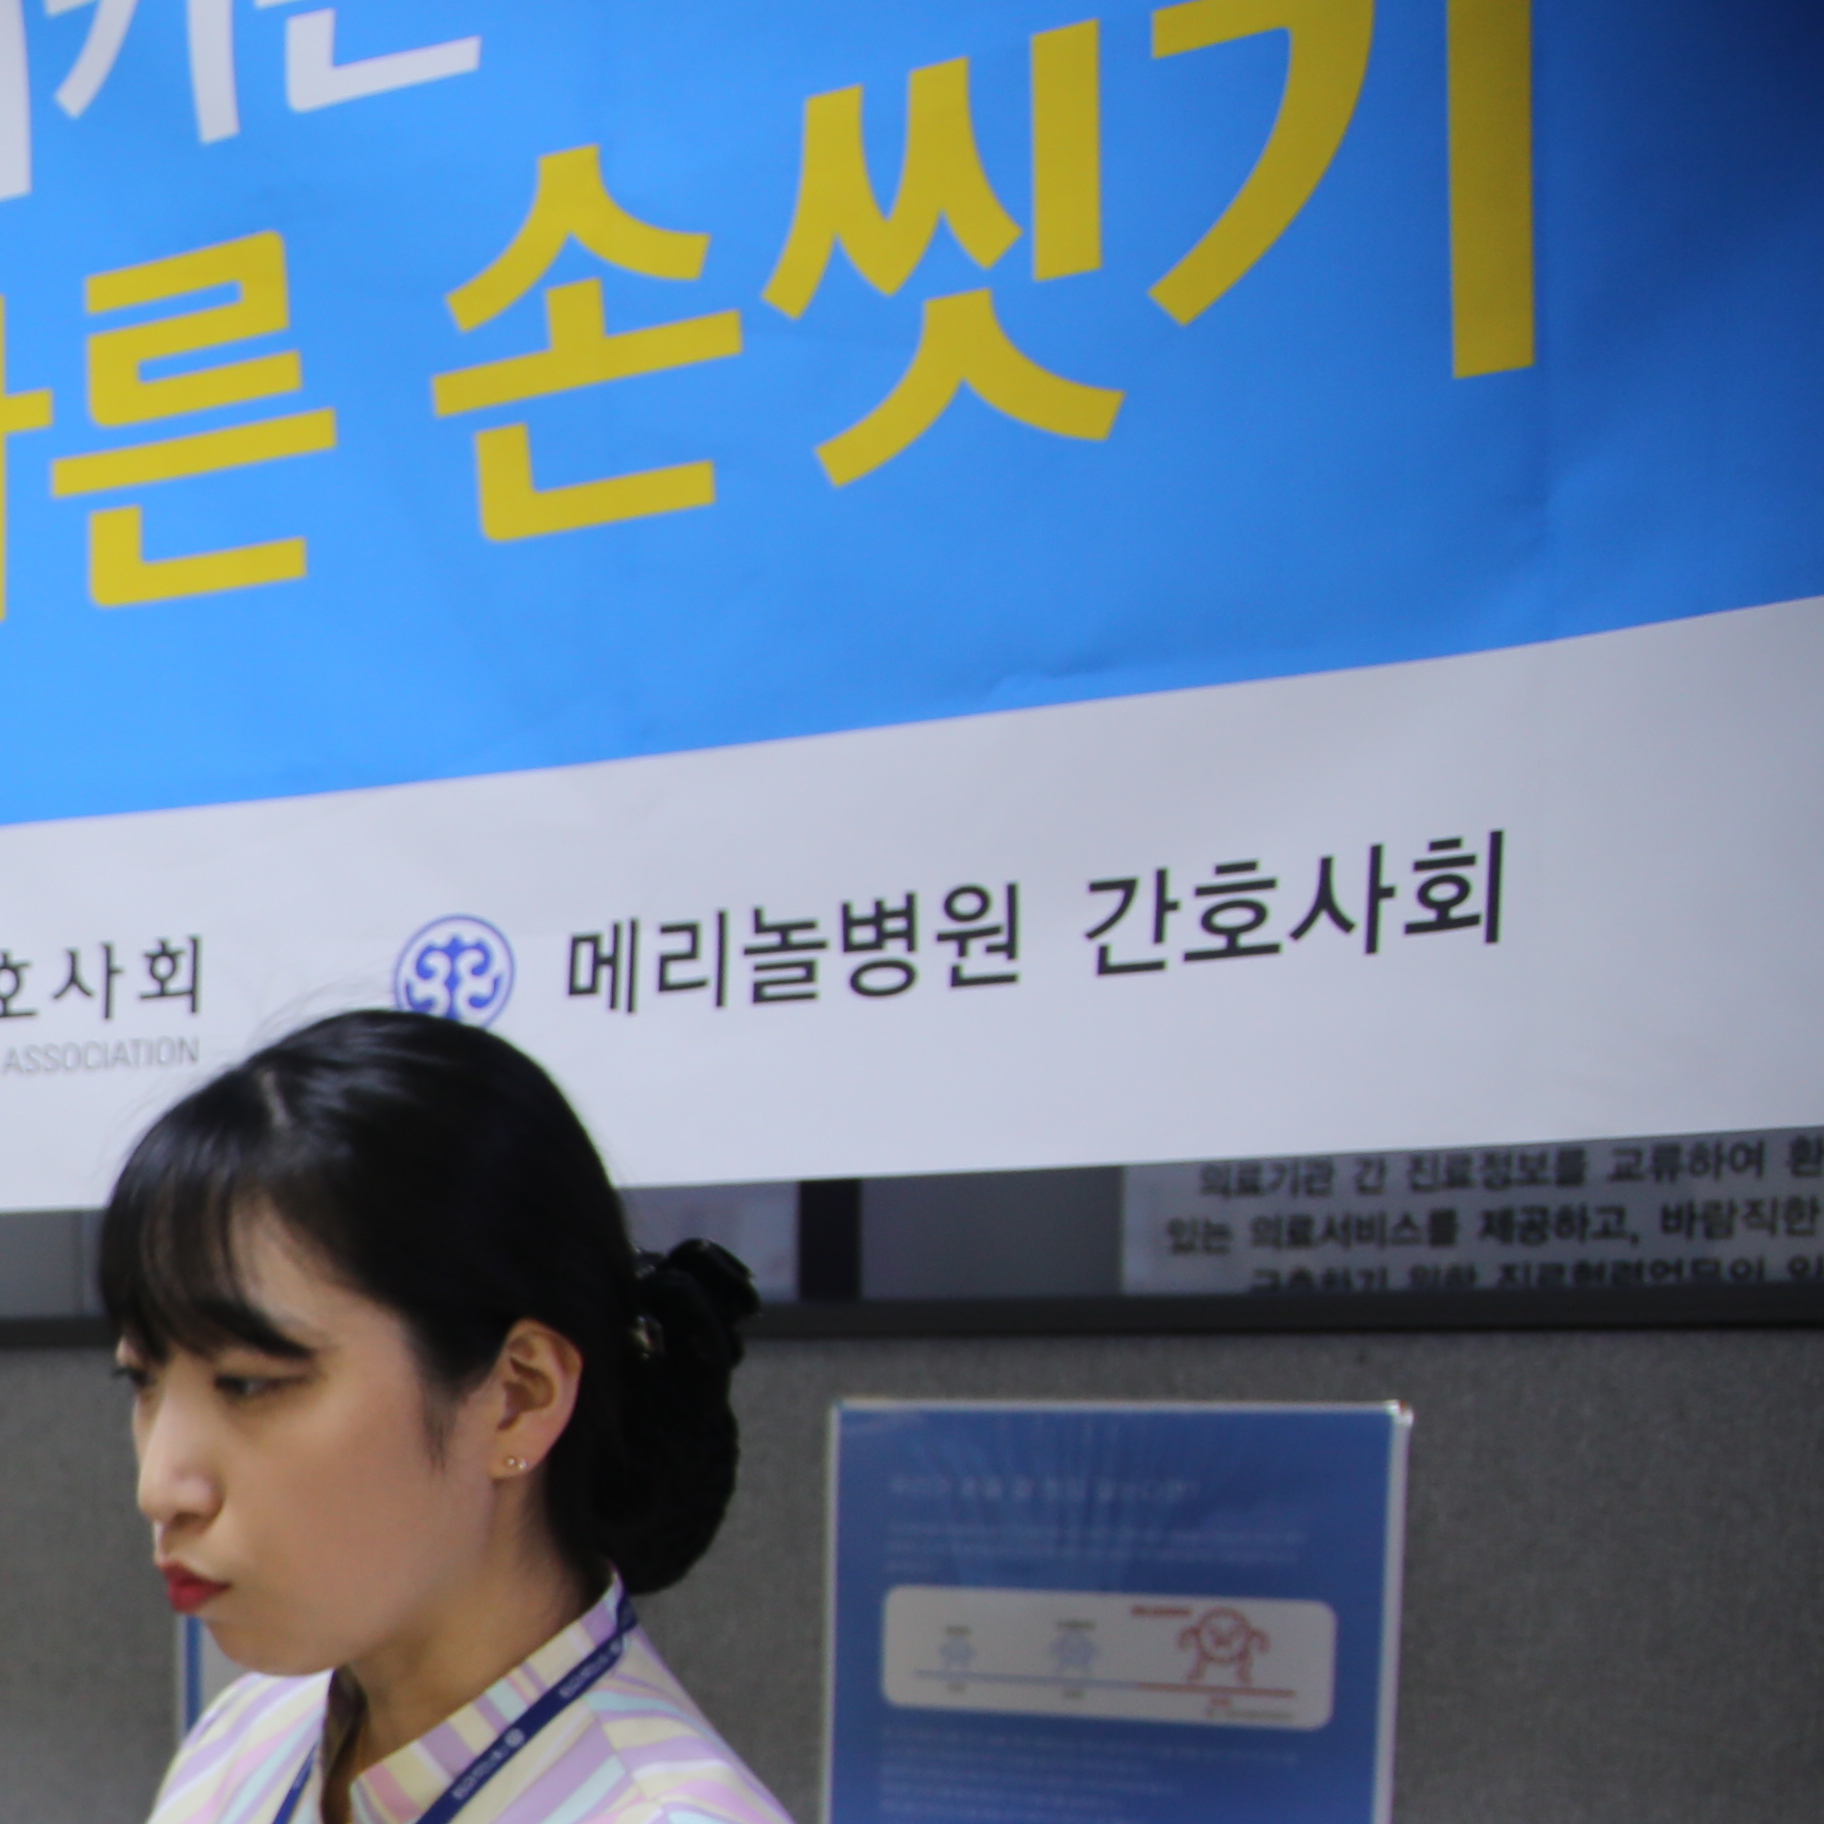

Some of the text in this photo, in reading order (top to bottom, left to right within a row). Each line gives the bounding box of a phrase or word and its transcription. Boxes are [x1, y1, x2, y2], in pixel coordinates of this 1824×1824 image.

[431, 0, 1536, 543] 손씻기
[565, 829, 1506, 1014] 메리놀병원 간호사회
[1, 1035, 202, 1076] ASSOCIATION
[1201, 1156, 1335, 1200] 의료기관
[1355, 1155, 1387, 1196] 간
[1409, 1147, 1588, 1193] 진료정보를
[1608, 1141, 1766, 1186] 교류하여
[1167, 1196, 1820, 1254] 있는 의료서비스를 제공하고, 바람직한
